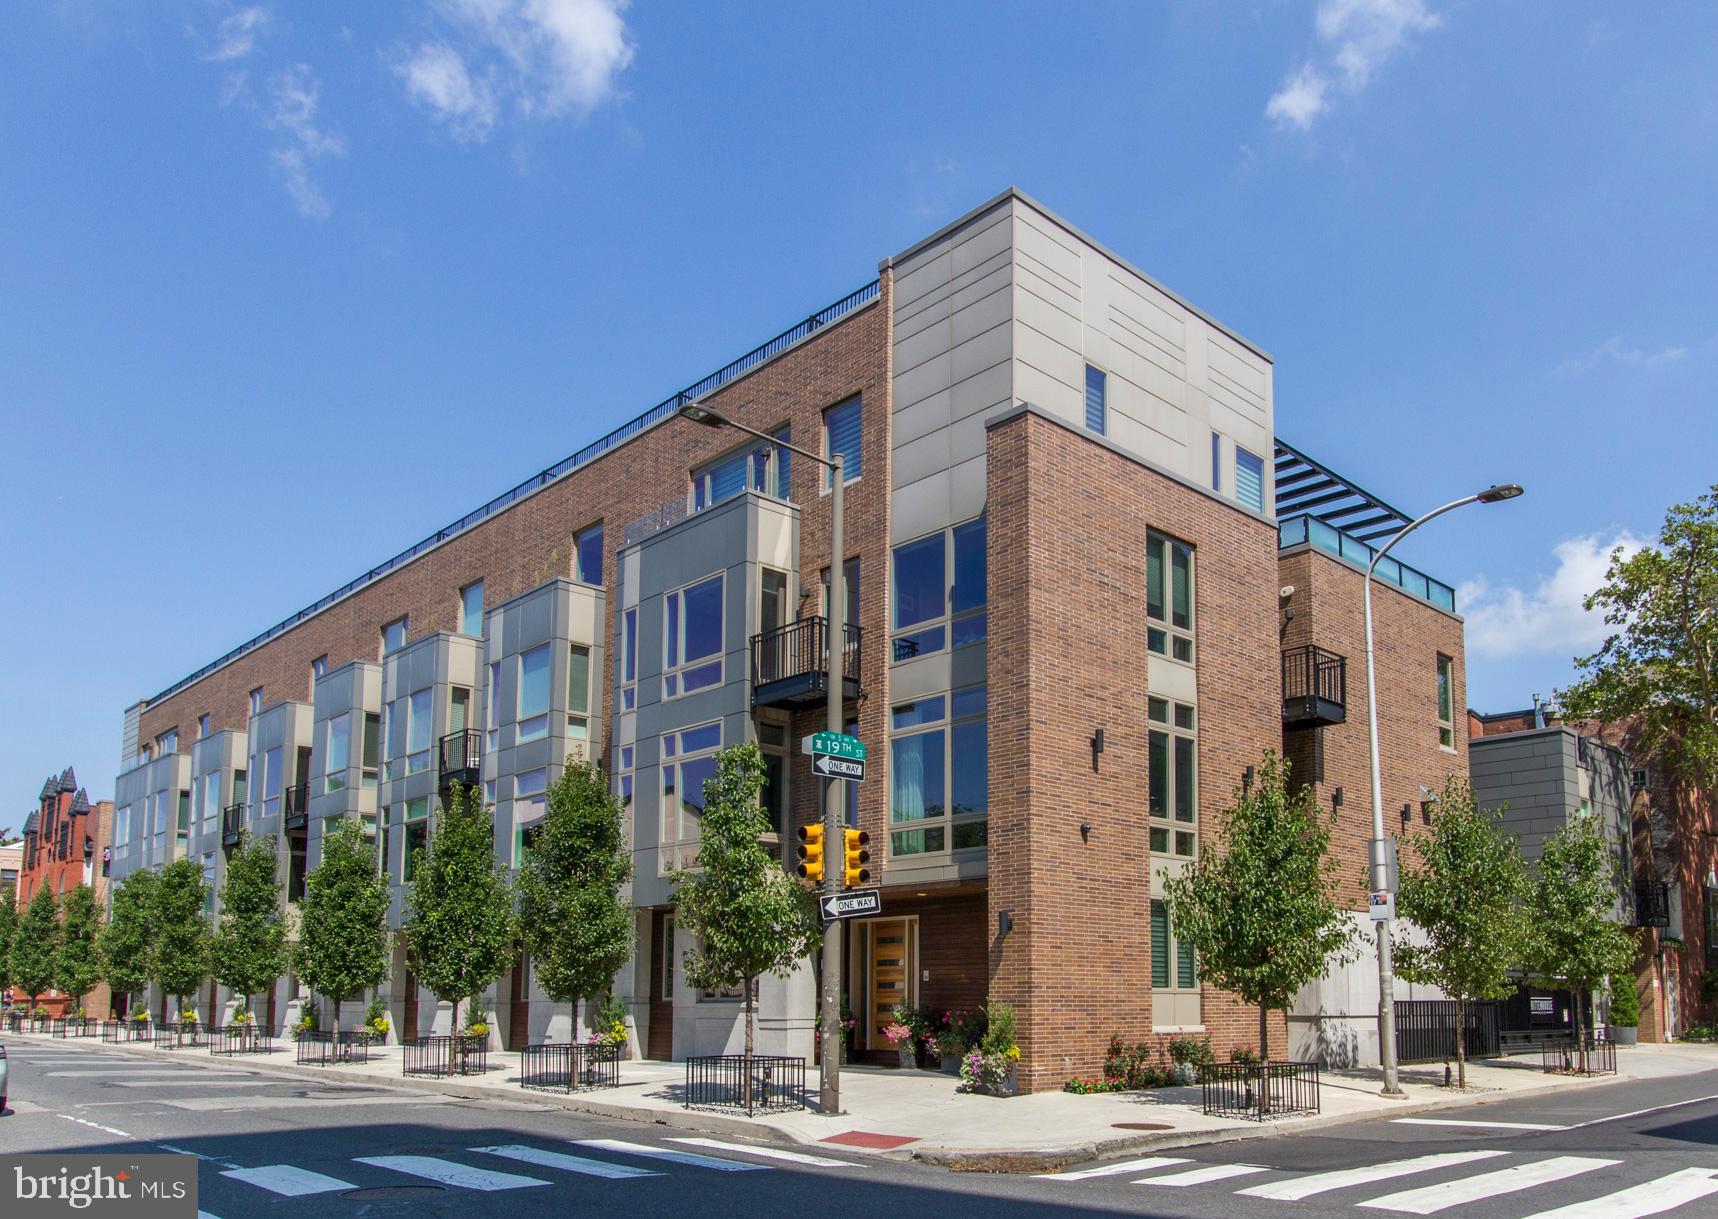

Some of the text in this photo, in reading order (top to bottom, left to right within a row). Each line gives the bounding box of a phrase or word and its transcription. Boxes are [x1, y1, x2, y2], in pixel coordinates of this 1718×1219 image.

[855, 749, 863, 758] ST
[828, 760, 860, 774] ONE WAY
[838, 898, 873, 910] ONE WAY
